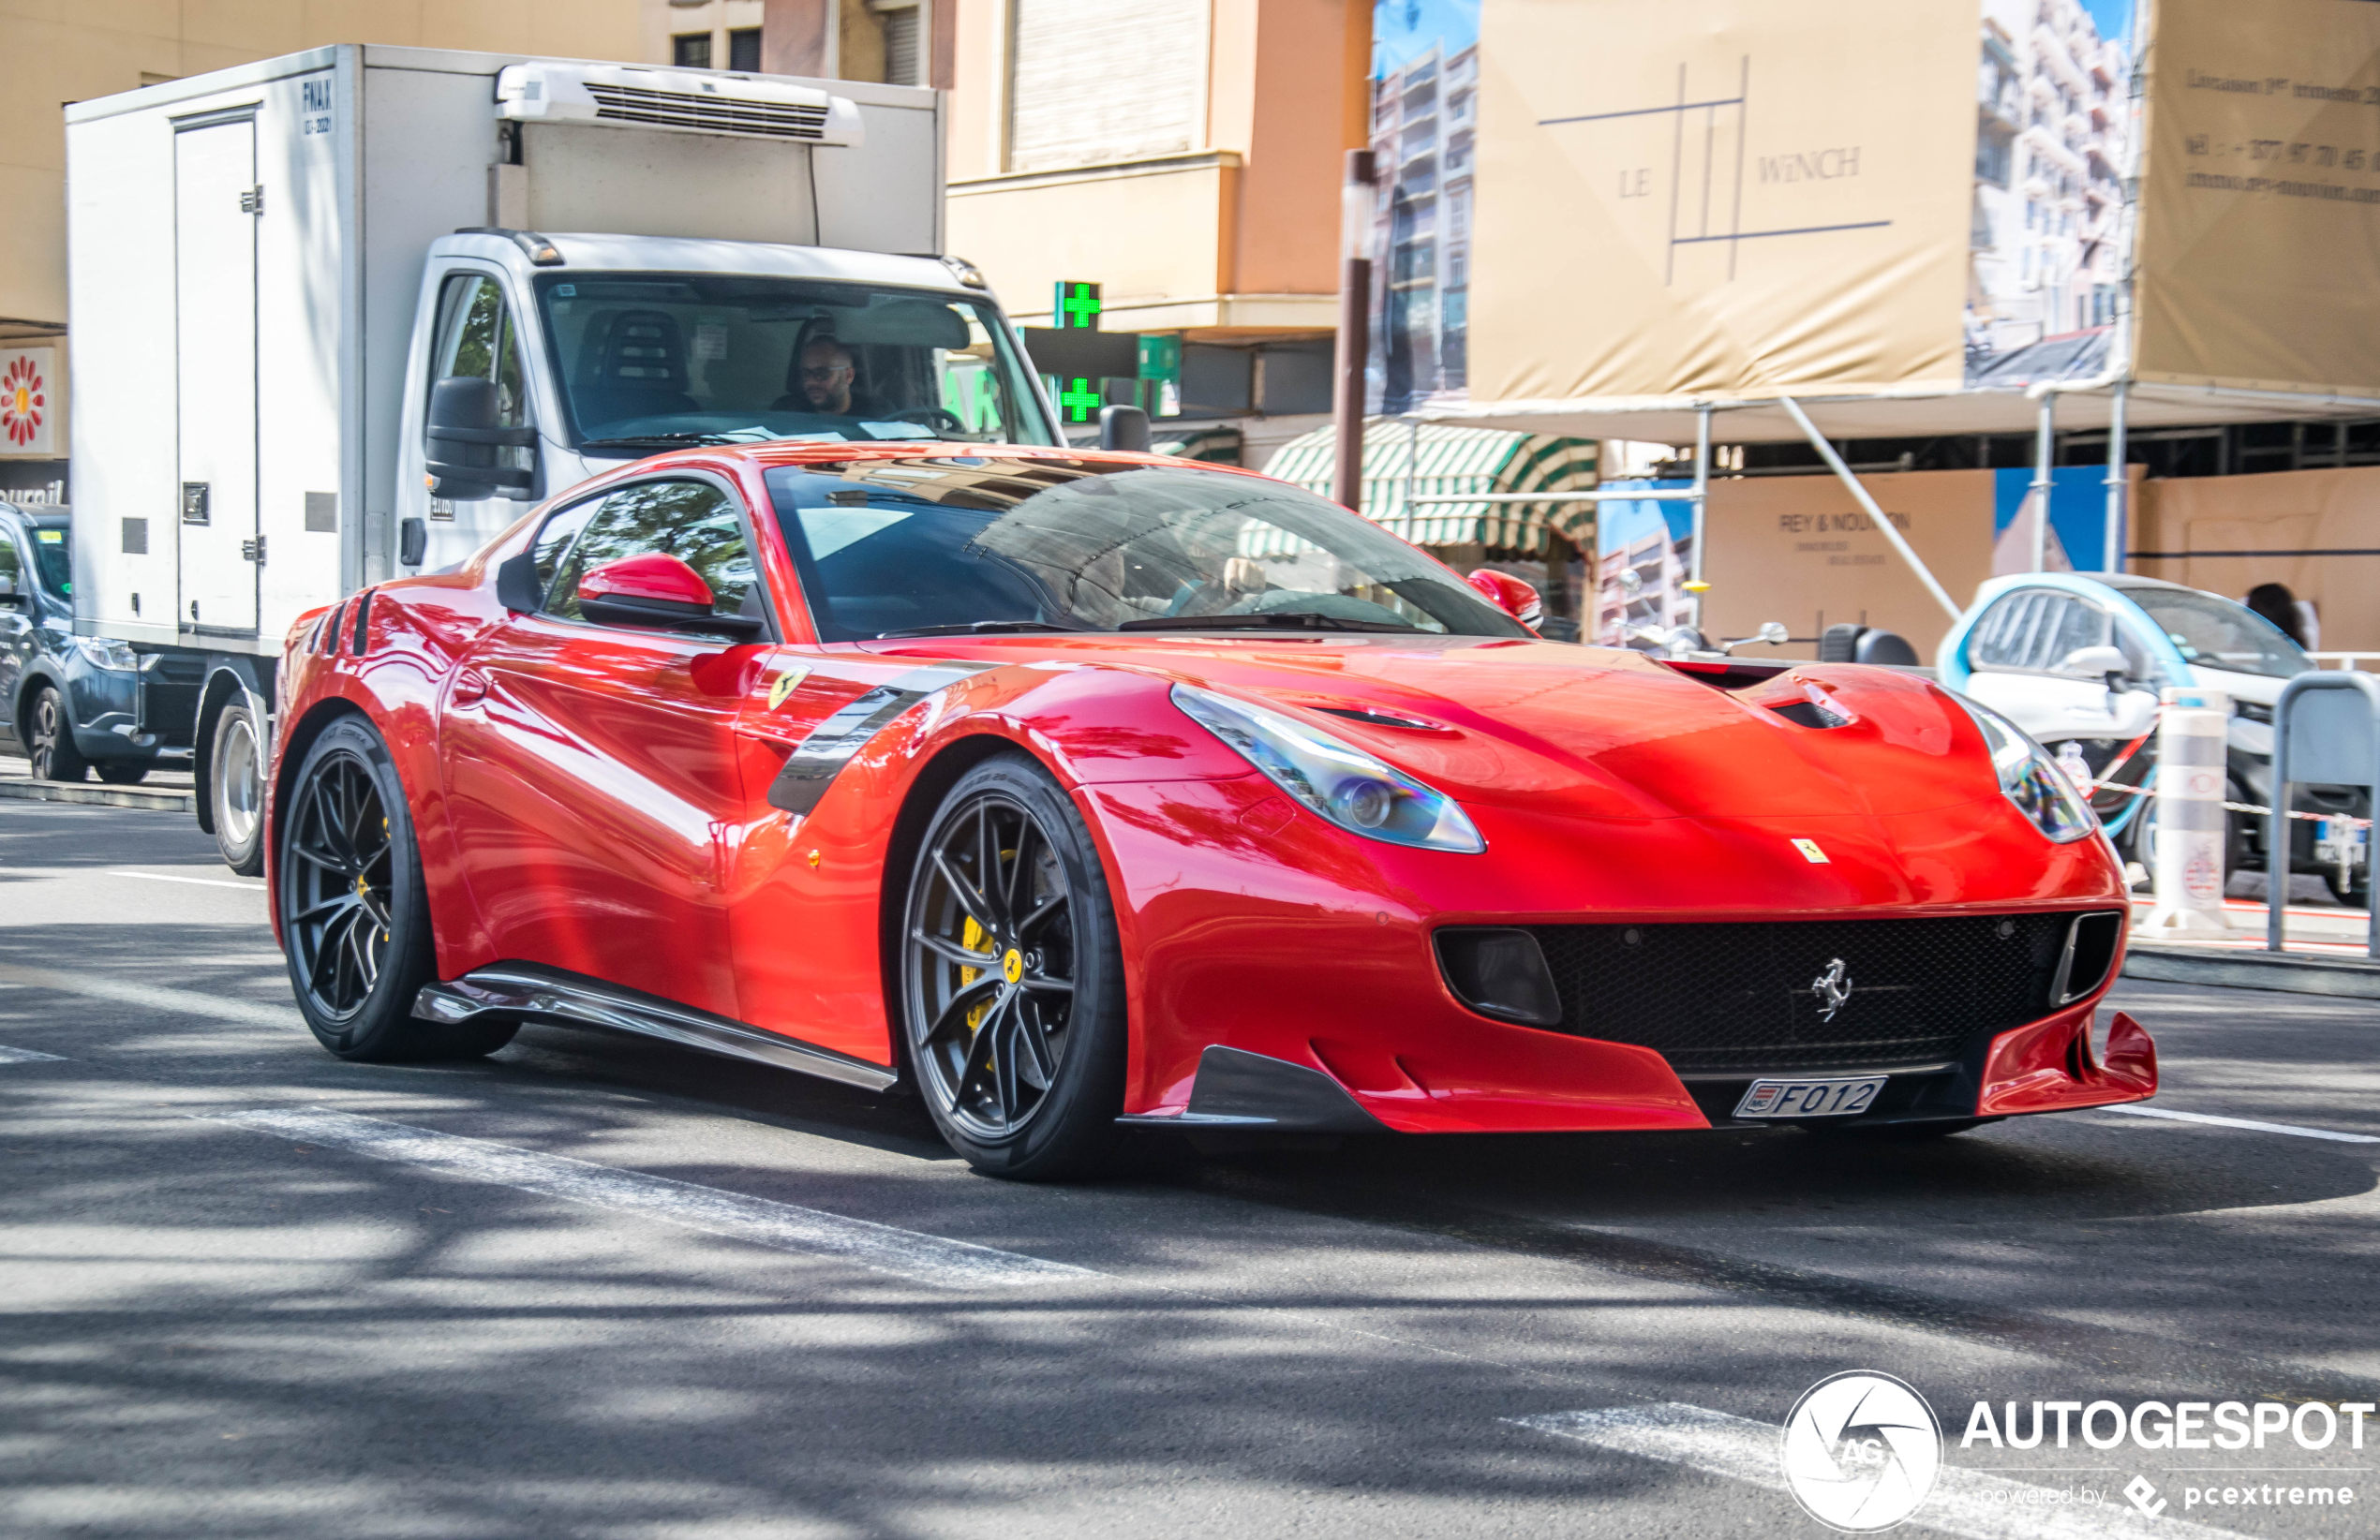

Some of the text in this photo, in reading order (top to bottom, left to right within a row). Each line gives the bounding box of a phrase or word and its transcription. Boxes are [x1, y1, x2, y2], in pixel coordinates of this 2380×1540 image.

[303, 79, 332, 113] FNAX
[1618, 168, 1651, 200] LE
[1779, 513, 1814, 532] REY
[1831, 512, 1911, 531] NOUON
[1751, 1083, 1876, 1114] MC F012
